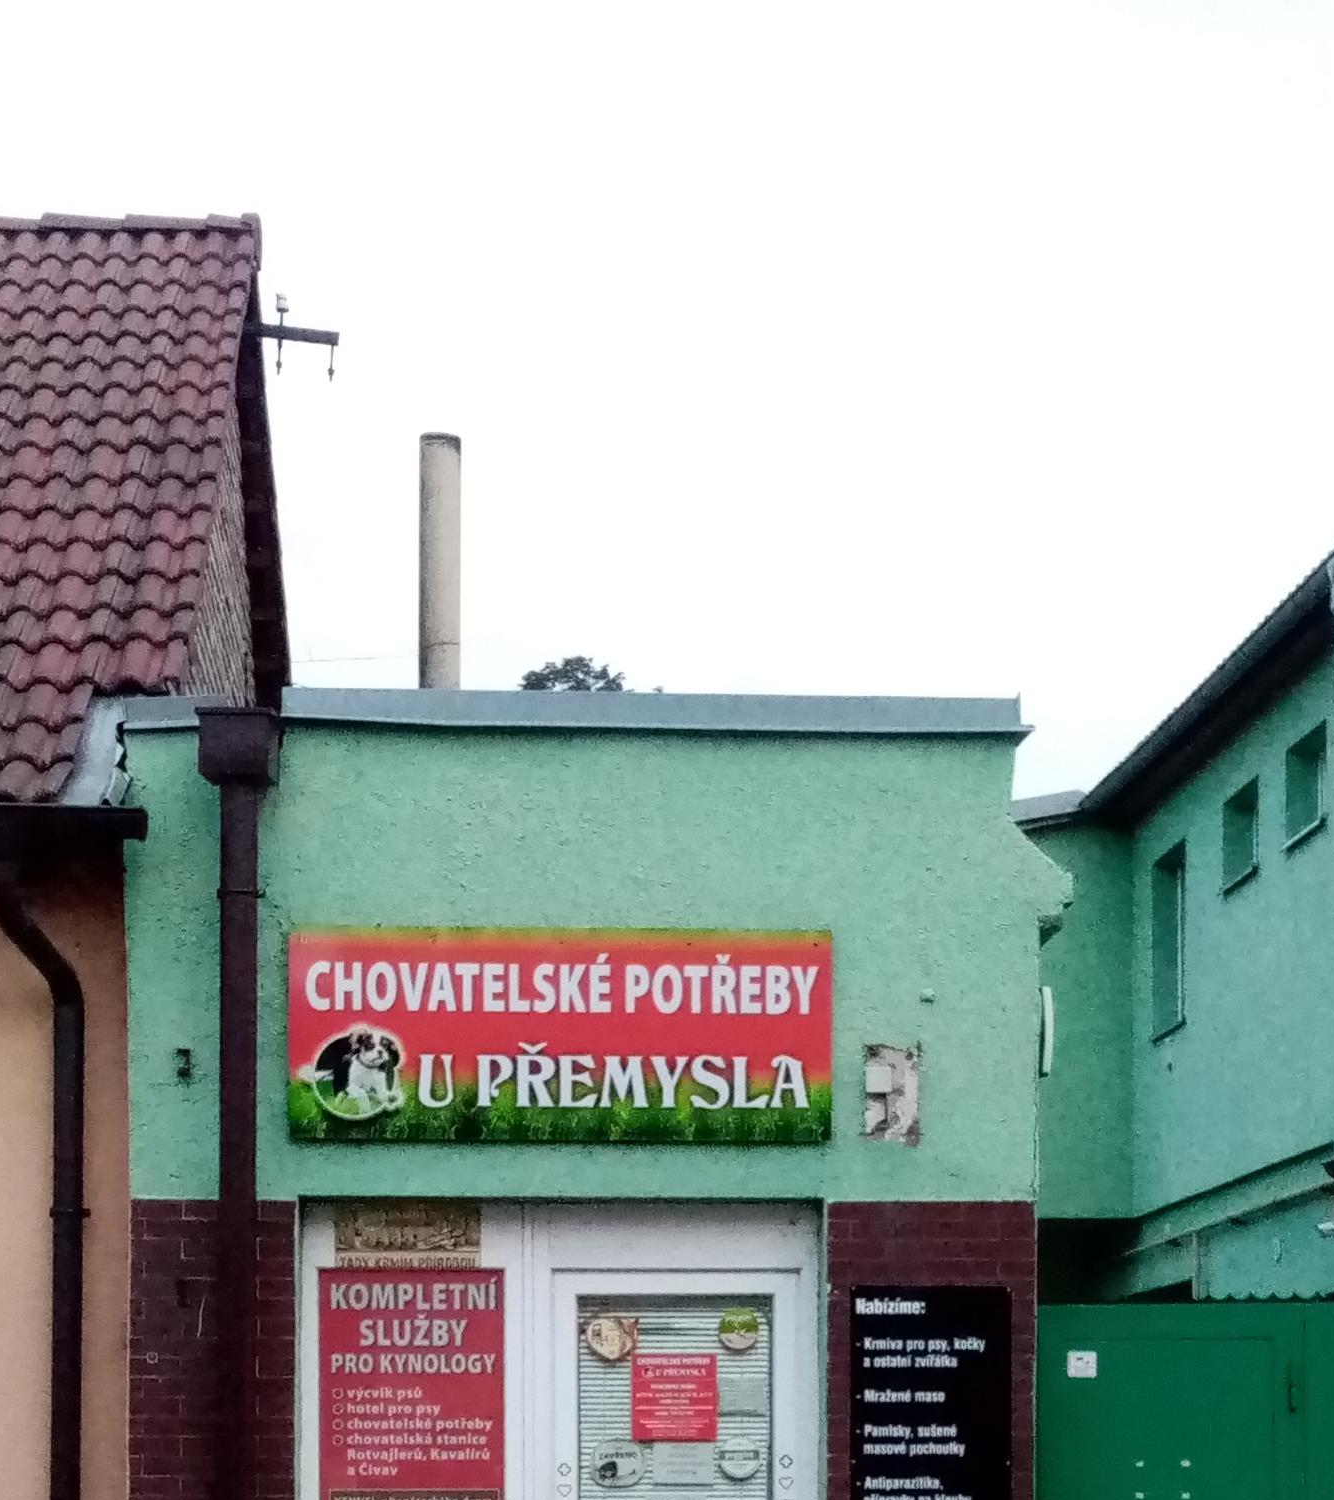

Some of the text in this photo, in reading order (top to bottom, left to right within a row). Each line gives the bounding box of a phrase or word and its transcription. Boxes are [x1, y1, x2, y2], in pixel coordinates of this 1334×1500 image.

[304, 953, 819, 1015] CHOVATELSKÉ POTŘEBY
[416, 1041, 810, 1110] U PŘEMYSLA
[330, 1277, 497, 1311] KOMPLETNÍ
[855, 1298, 926, 1315] Nabízíme:
[359, 1313, 468, 1347] SLUŽBY
[863, 1337, 903, 1351] Krmiva
[906, 1339, 926, 1353] pro
[928, 1339, 951, 1353] psy,
[953, 1336, 986, 1353] kočky
[330, 1353, 496, 1375] PRO KYNOLOGY
[863, 1353, 958, 1368] a ostatní zvířátka
[397, 1386, 423, 1402] psů
[864, 1388, 913, 1403] Mražené
[914, 1391, 946, 1403] maso
[347, 1402, 441, 1418] hotel pro psy
[347, 1417, 493, 1434] chovatelské potřeby
[917, 1423, 958, 1438] sušené
[347, 1432, 487, 1446] chovatelská stanice
[863, 1441, 966, 1458] masové pochoutky
[347, 1466, 355, 1476] a
